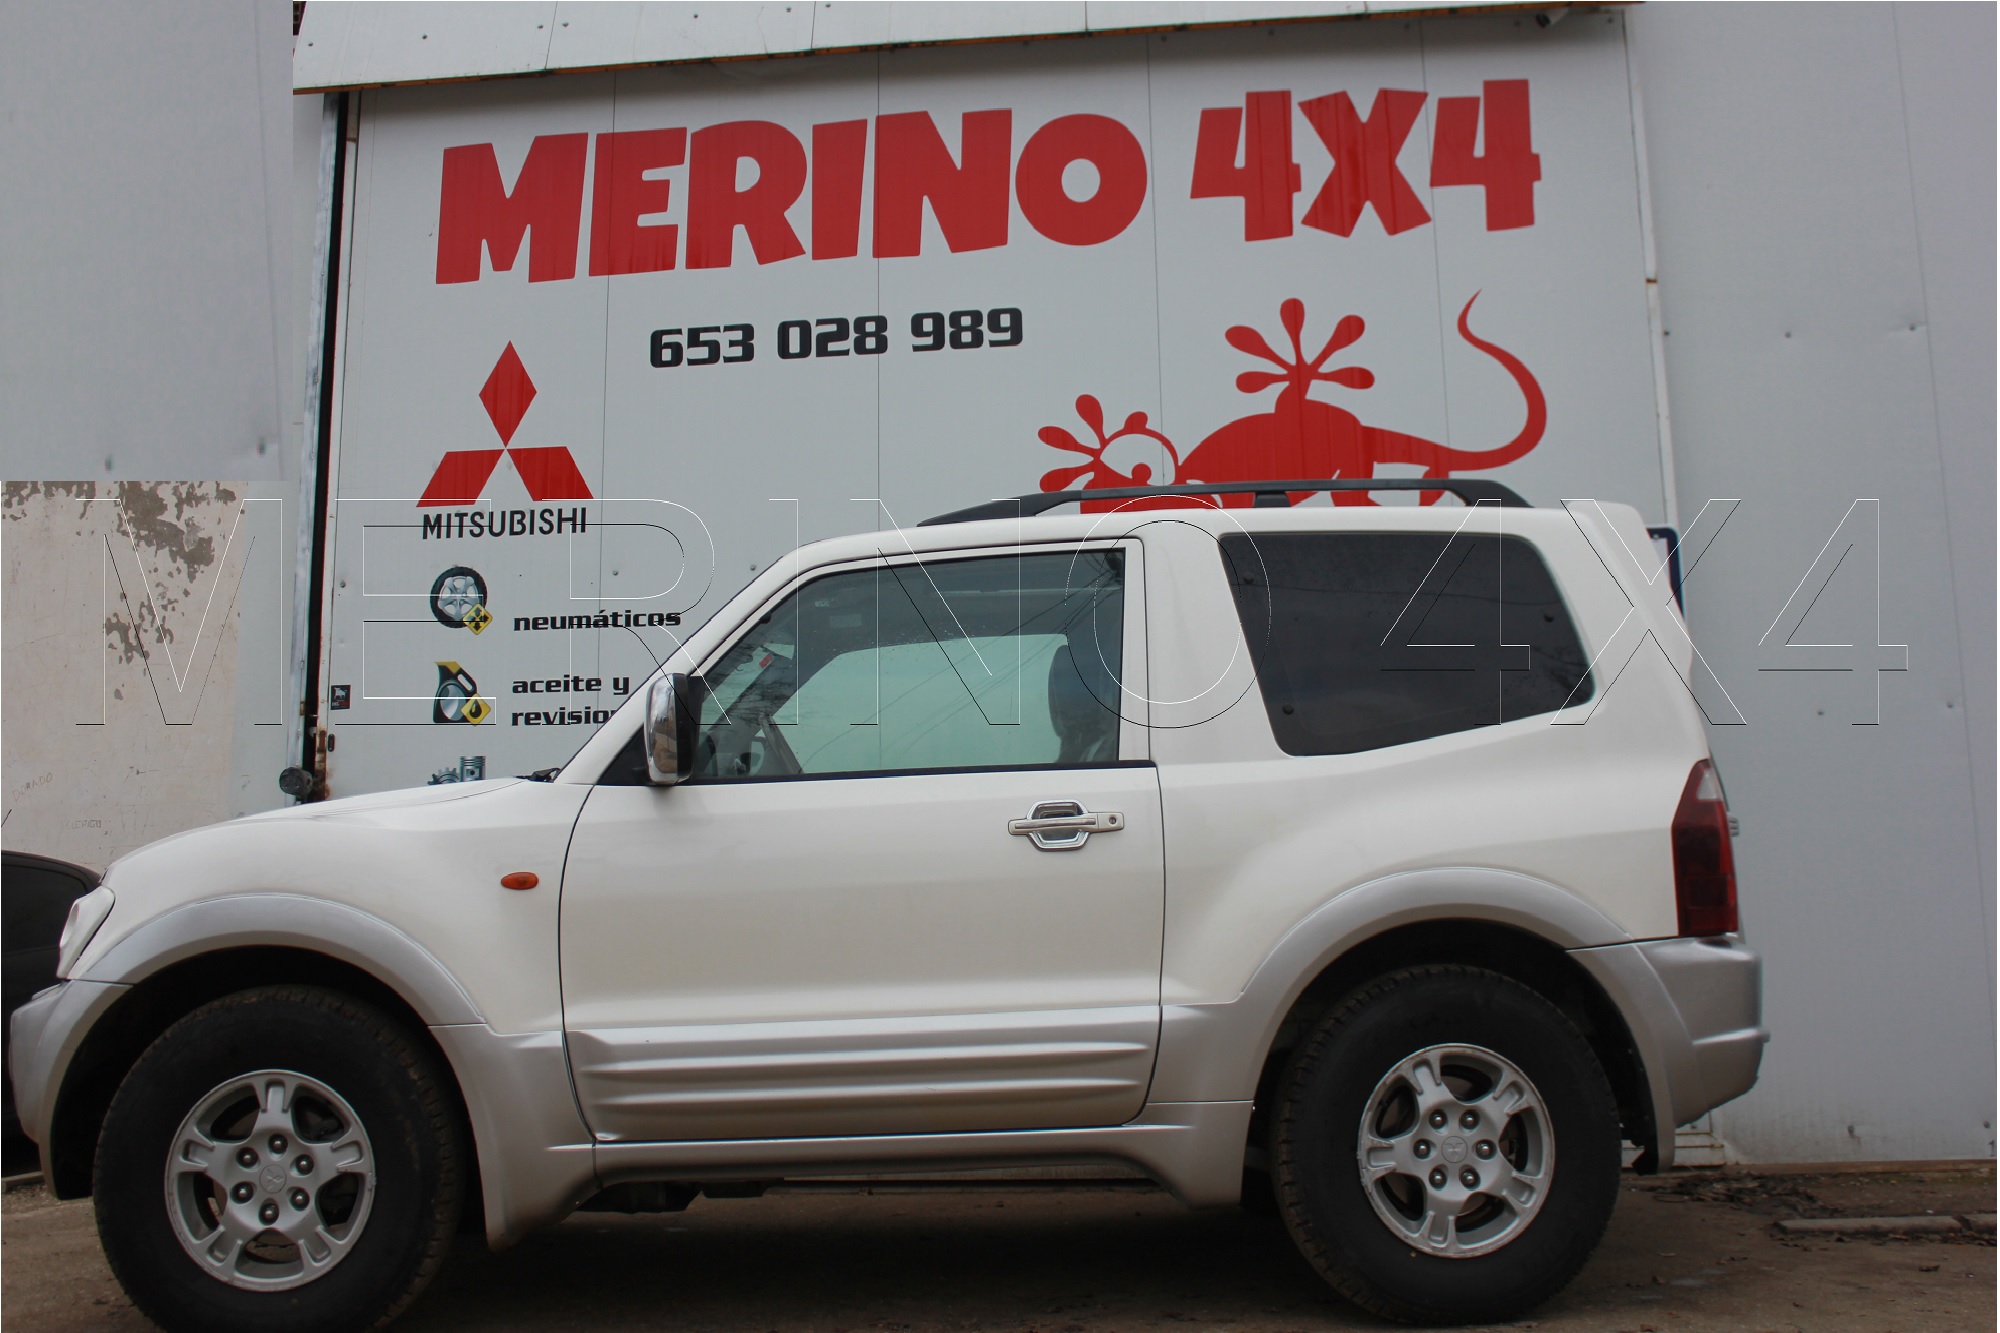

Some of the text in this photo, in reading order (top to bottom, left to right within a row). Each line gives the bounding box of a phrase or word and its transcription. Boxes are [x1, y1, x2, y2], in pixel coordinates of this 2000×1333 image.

[435, 78, 1542, 285] MERINO 4X4
[649, 307, 1024, 368] 653 028 989
[422, 507, 587, 540] MITSUBISHI
[513, 609, 682, 631] neumáticos
[512, 674, 630, 695] aceite y
[511, 705, 617, 727] revisio
